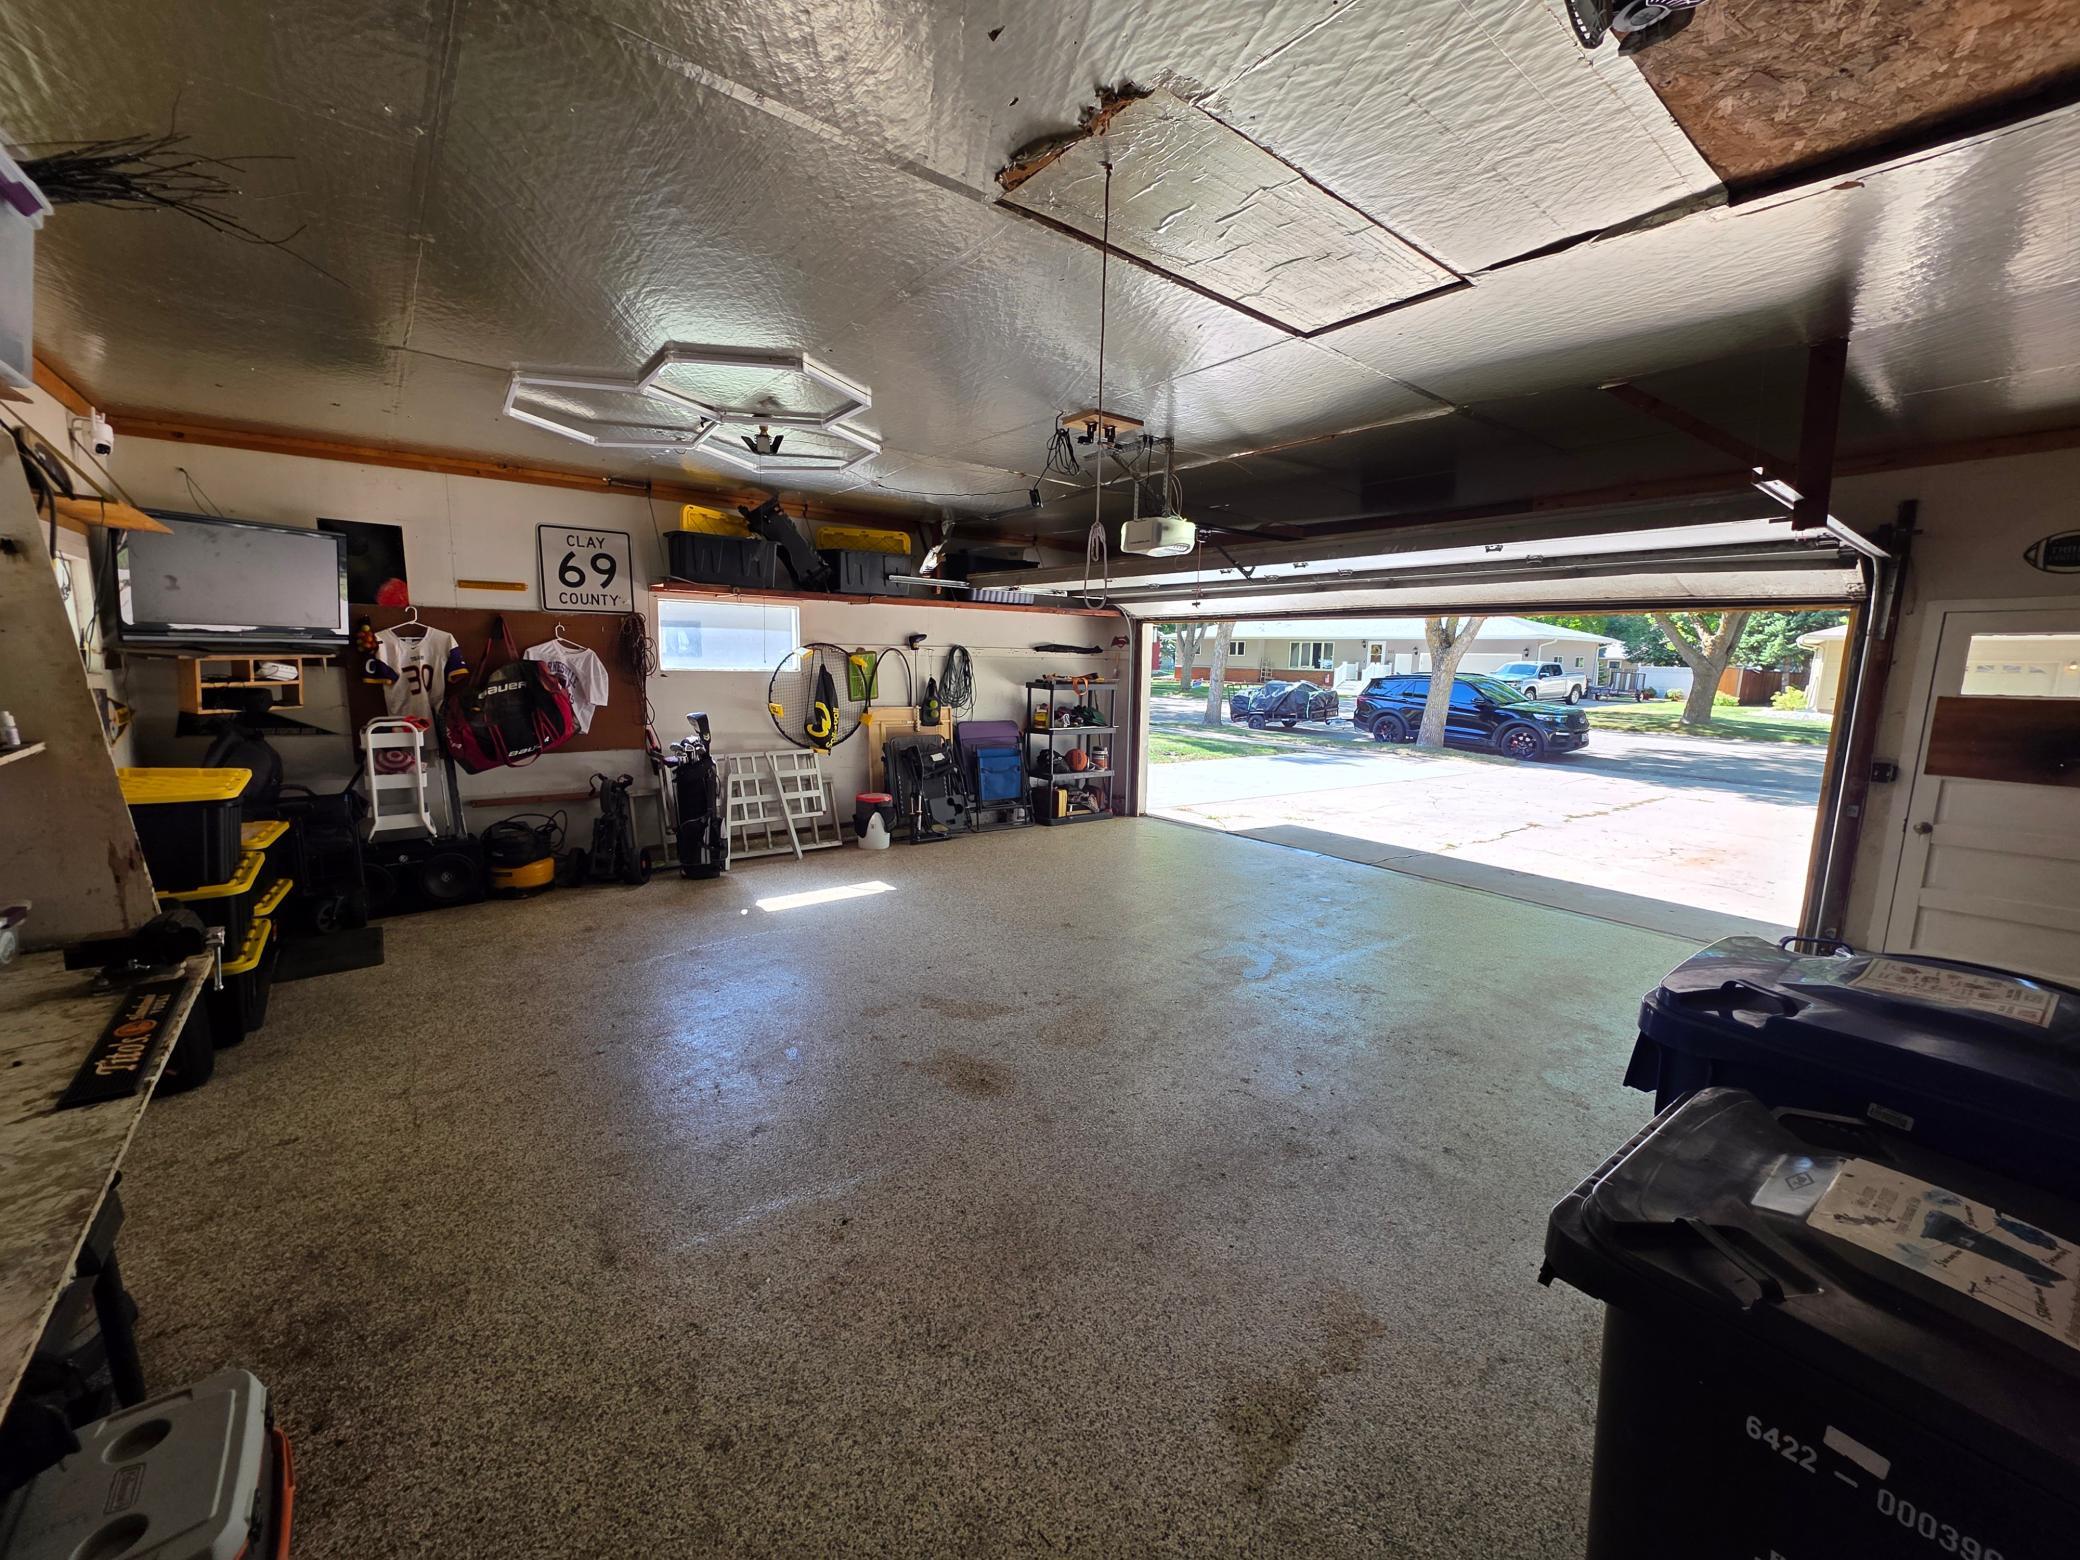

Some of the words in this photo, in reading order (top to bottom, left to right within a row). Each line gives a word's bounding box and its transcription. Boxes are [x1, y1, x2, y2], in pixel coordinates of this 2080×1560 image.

[566, 534, 606, 549] CLAY
[558, 551, 617, 589] 69
[559, 592, 619, 606] COUNTY
[402, 665, 434, 695] 30
[1745, 1415, 1818, 1474] 6422
